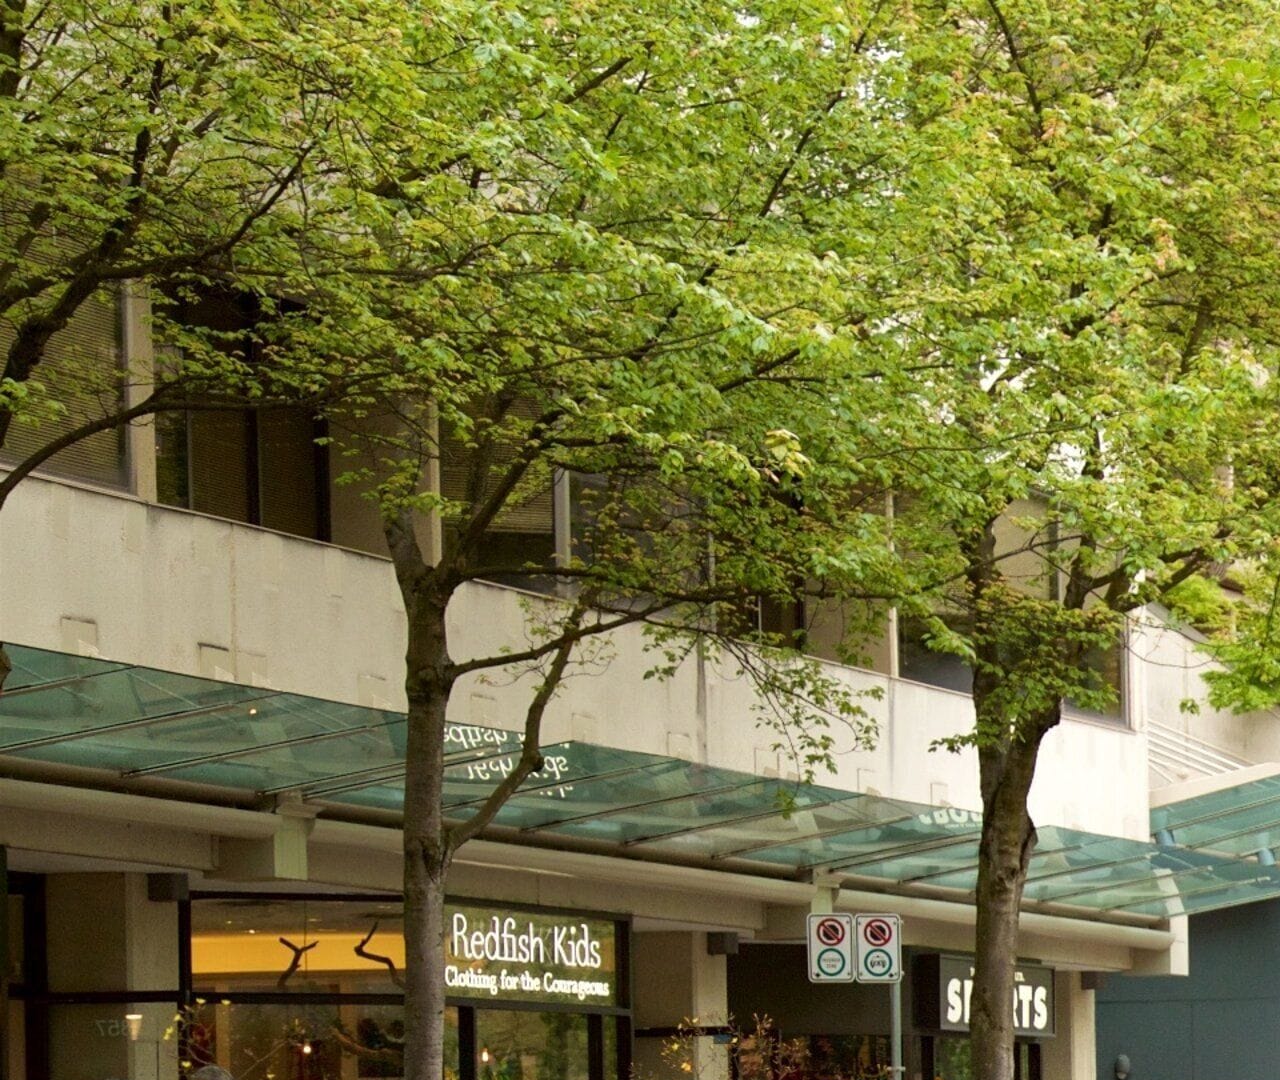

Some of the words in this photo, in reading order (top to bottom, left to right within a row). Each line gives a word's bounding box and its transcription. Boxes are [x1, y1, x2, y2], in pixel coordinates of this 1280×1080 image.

[452, 913, 544, 963] Redfish
[553, 923, 601, 968] Kids
[445, 965, 498, 995] Clothing
[500, 968, 521, 991] for
[520, 970, 541, 991] the
[543, 972, 610, 1000] Courageous
